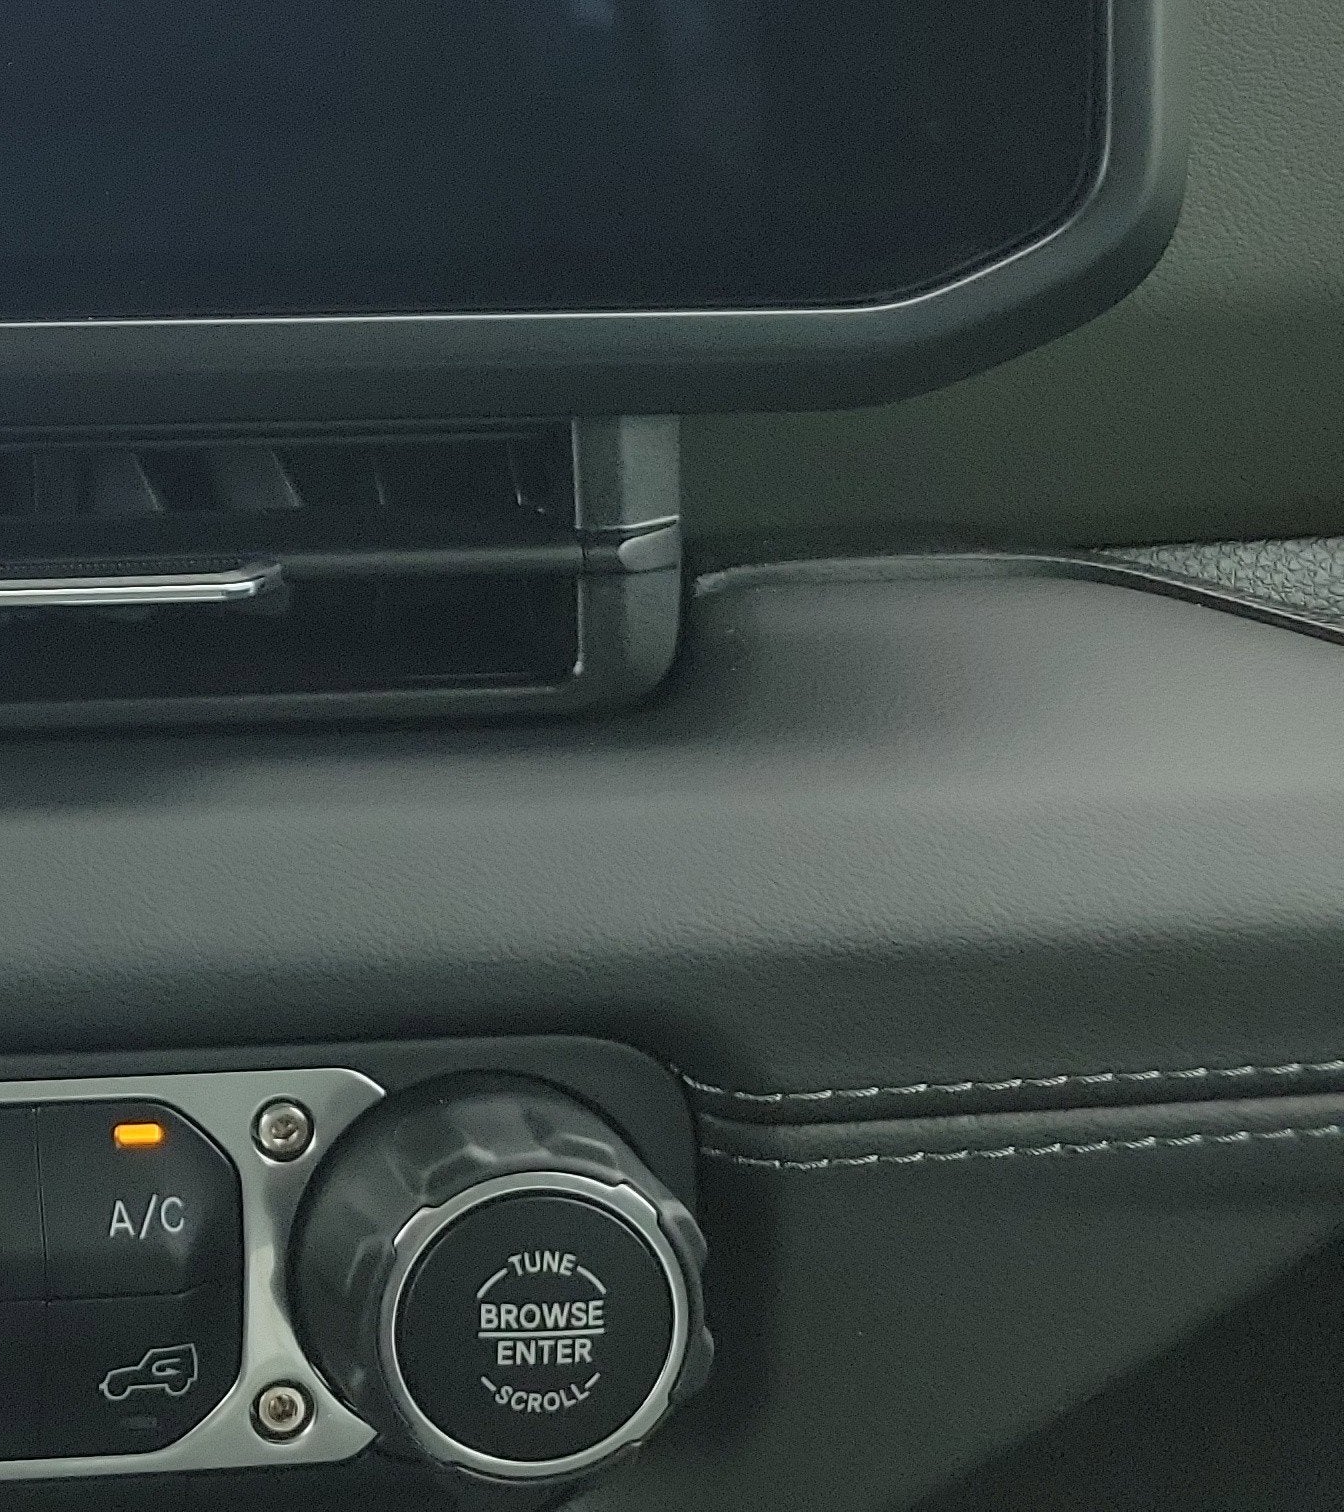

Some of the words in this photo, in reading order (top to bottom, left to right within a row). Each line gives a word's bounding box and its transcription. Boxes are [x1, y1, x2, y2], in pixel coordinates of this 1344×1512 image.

[109, 1195, 186, 1240] A/C
[507, 1250, 577, 1276] TUNE
[480, 1300, 605, 1330] BROWSE
[496, 1338, 593, 1366] ENTER
[494, 1382, 590, 1413] SCROLL
